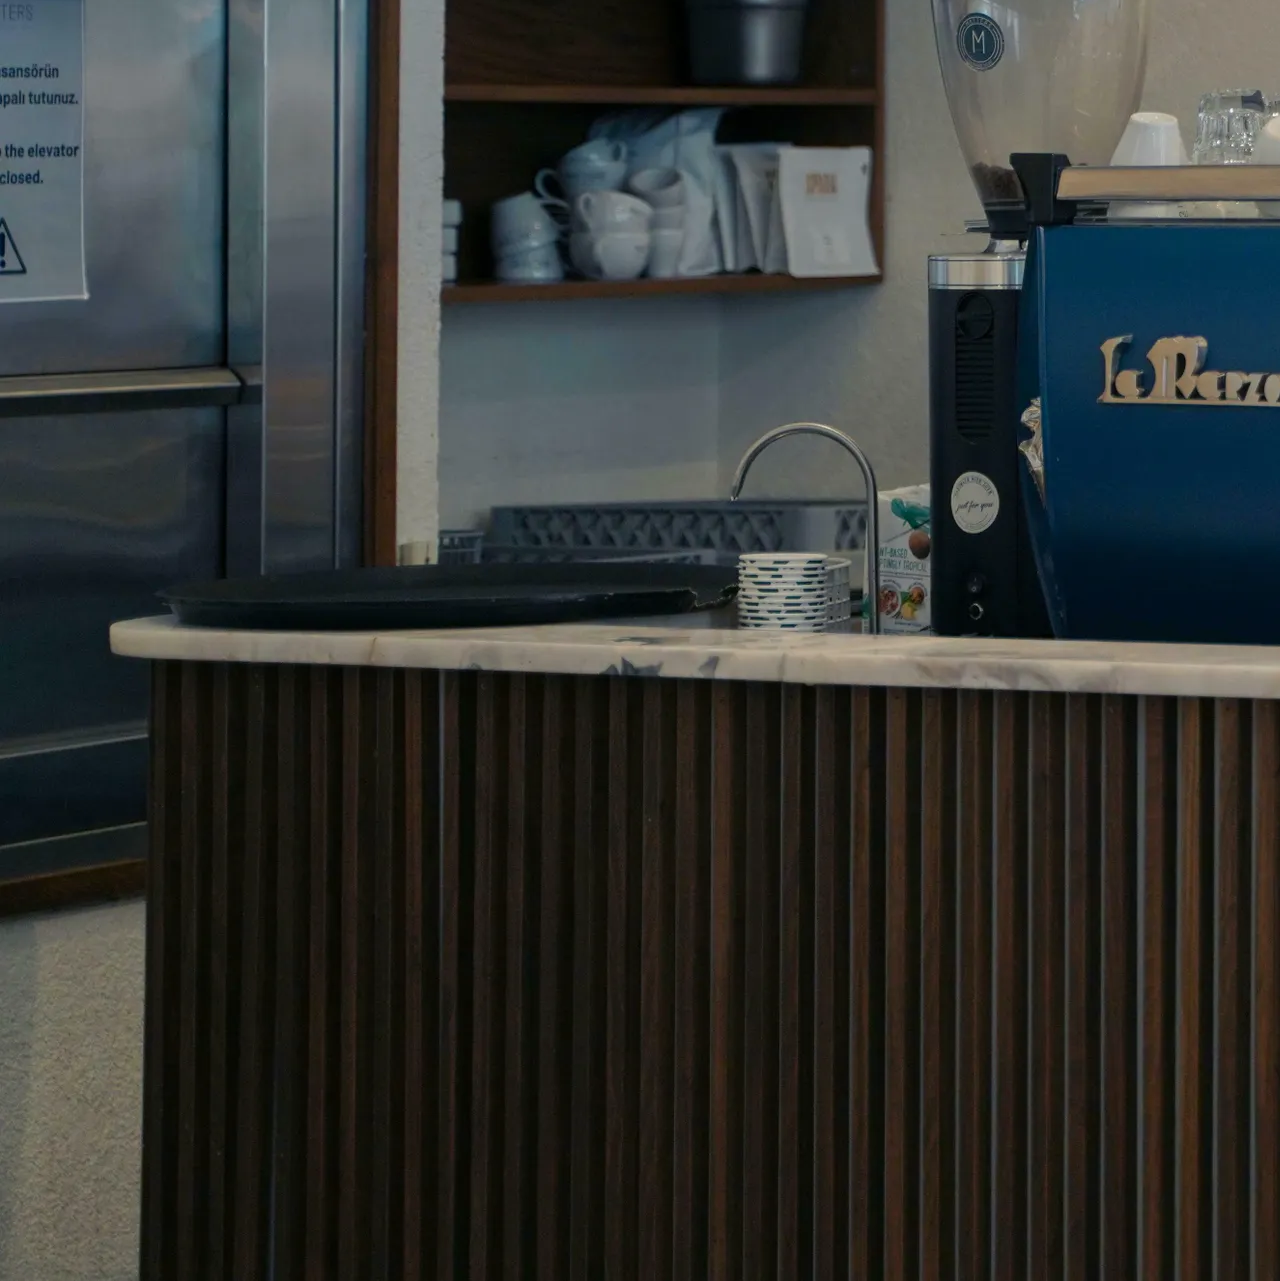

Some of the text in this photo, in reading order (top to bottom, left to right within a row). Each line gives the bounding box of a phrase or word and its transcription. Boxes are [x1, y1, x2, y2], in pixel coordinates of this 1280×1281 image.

[972, 30, 985, 54] M
[0, 64, 59, 79] sansörün
[28, 91, 79, 105] tutunuz.
[5, 142, 79, 158] the elevator
[0, 169, 44, 185] closed.
[1098, 334, 1144, 402] La
